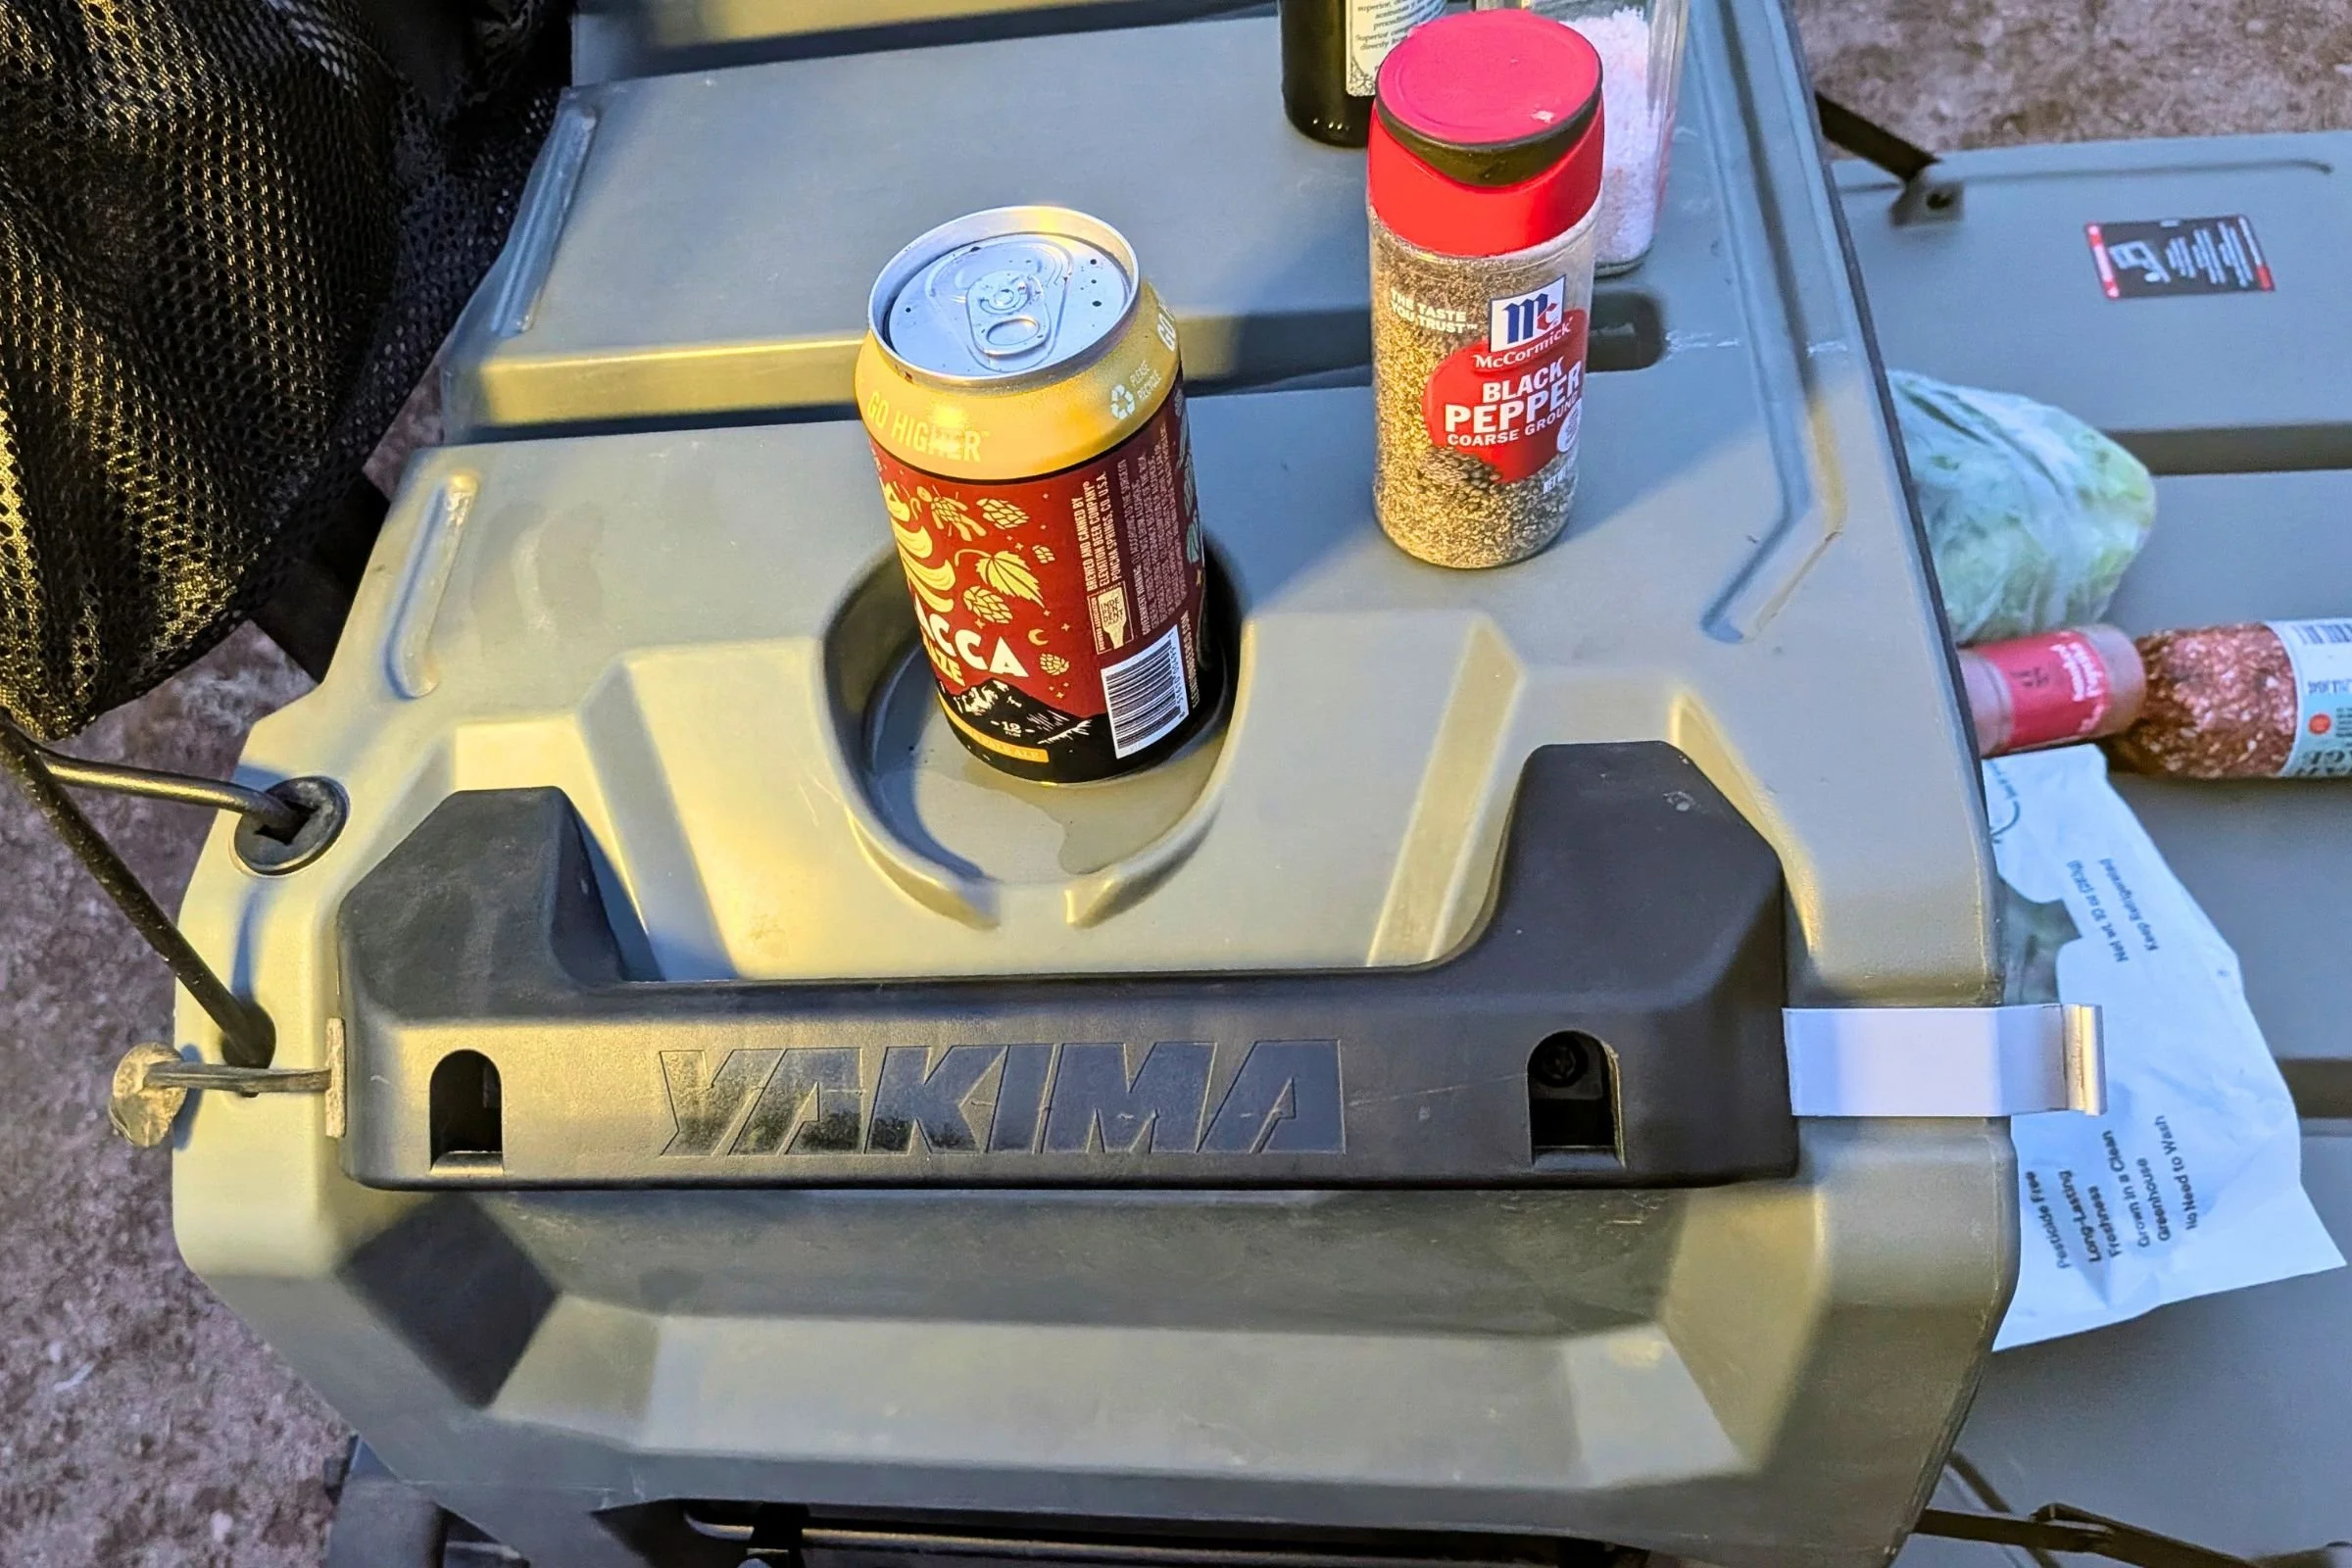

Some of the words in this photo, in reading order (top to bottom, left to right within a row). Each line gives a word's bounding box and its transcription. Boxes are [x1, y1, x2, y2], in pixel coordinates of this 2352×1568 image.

[1391, 287, 1414, 311] THE
[1417, 302, 1467, 322] TASTE
[1391, 300, 1414, 322] YOU
[1157, 313, 1176, 352] GO
[1445, 360, 1583, 434] PEPPER
[1483, 357, 1565, 404] BLACK
[866, 391, 889, 429] GO
[1525, 392, 1578, 436] GROUND
[1447, 429, 1520, 447] COARSE
[1071, 497, 1084, 510] BY
[1074, 510, 1090, 542] CANNED
[1091, 523, 1103, 547] BEER
[1079, 541, 1093, 559] AND
[1094, 546, 1110, 587] ELEVATION
[1107, 549, 1122, 581] PONCHA
[1082, 559, 1098, 592] BREWED
[1101, 596, 1120, 610] INDE
[1103, 609, 1123, 623] DENT
[1137, 593, 1151, 636] GOVERNMENT
[1002, 720, 1022, 734] 12
[659, 1039, 1348, 1157] YAKIMA
[2101, 1130, 2125, 1172] Clean
[2154, 1115, 2178, 1155] Wash
[2119, 1174, 2131, 1183] a
[2171, 1155, 2185, 1172] to
[2026, 1171, 2045, 1202] Free
[2123, 1186, 2137, 1200] in
[2136, 1158, 2172, 1242] Greenhouse
[2174, 1174, 2197, 1212] Need
[2059, 1170, 2102, 1262] Long-Lasting
[2087, 1186, 2123, 1257] Freshness
[2129, 1201, 2150, 1248] Grown
[2038, 1205, 2071, 1268] Pesticide
